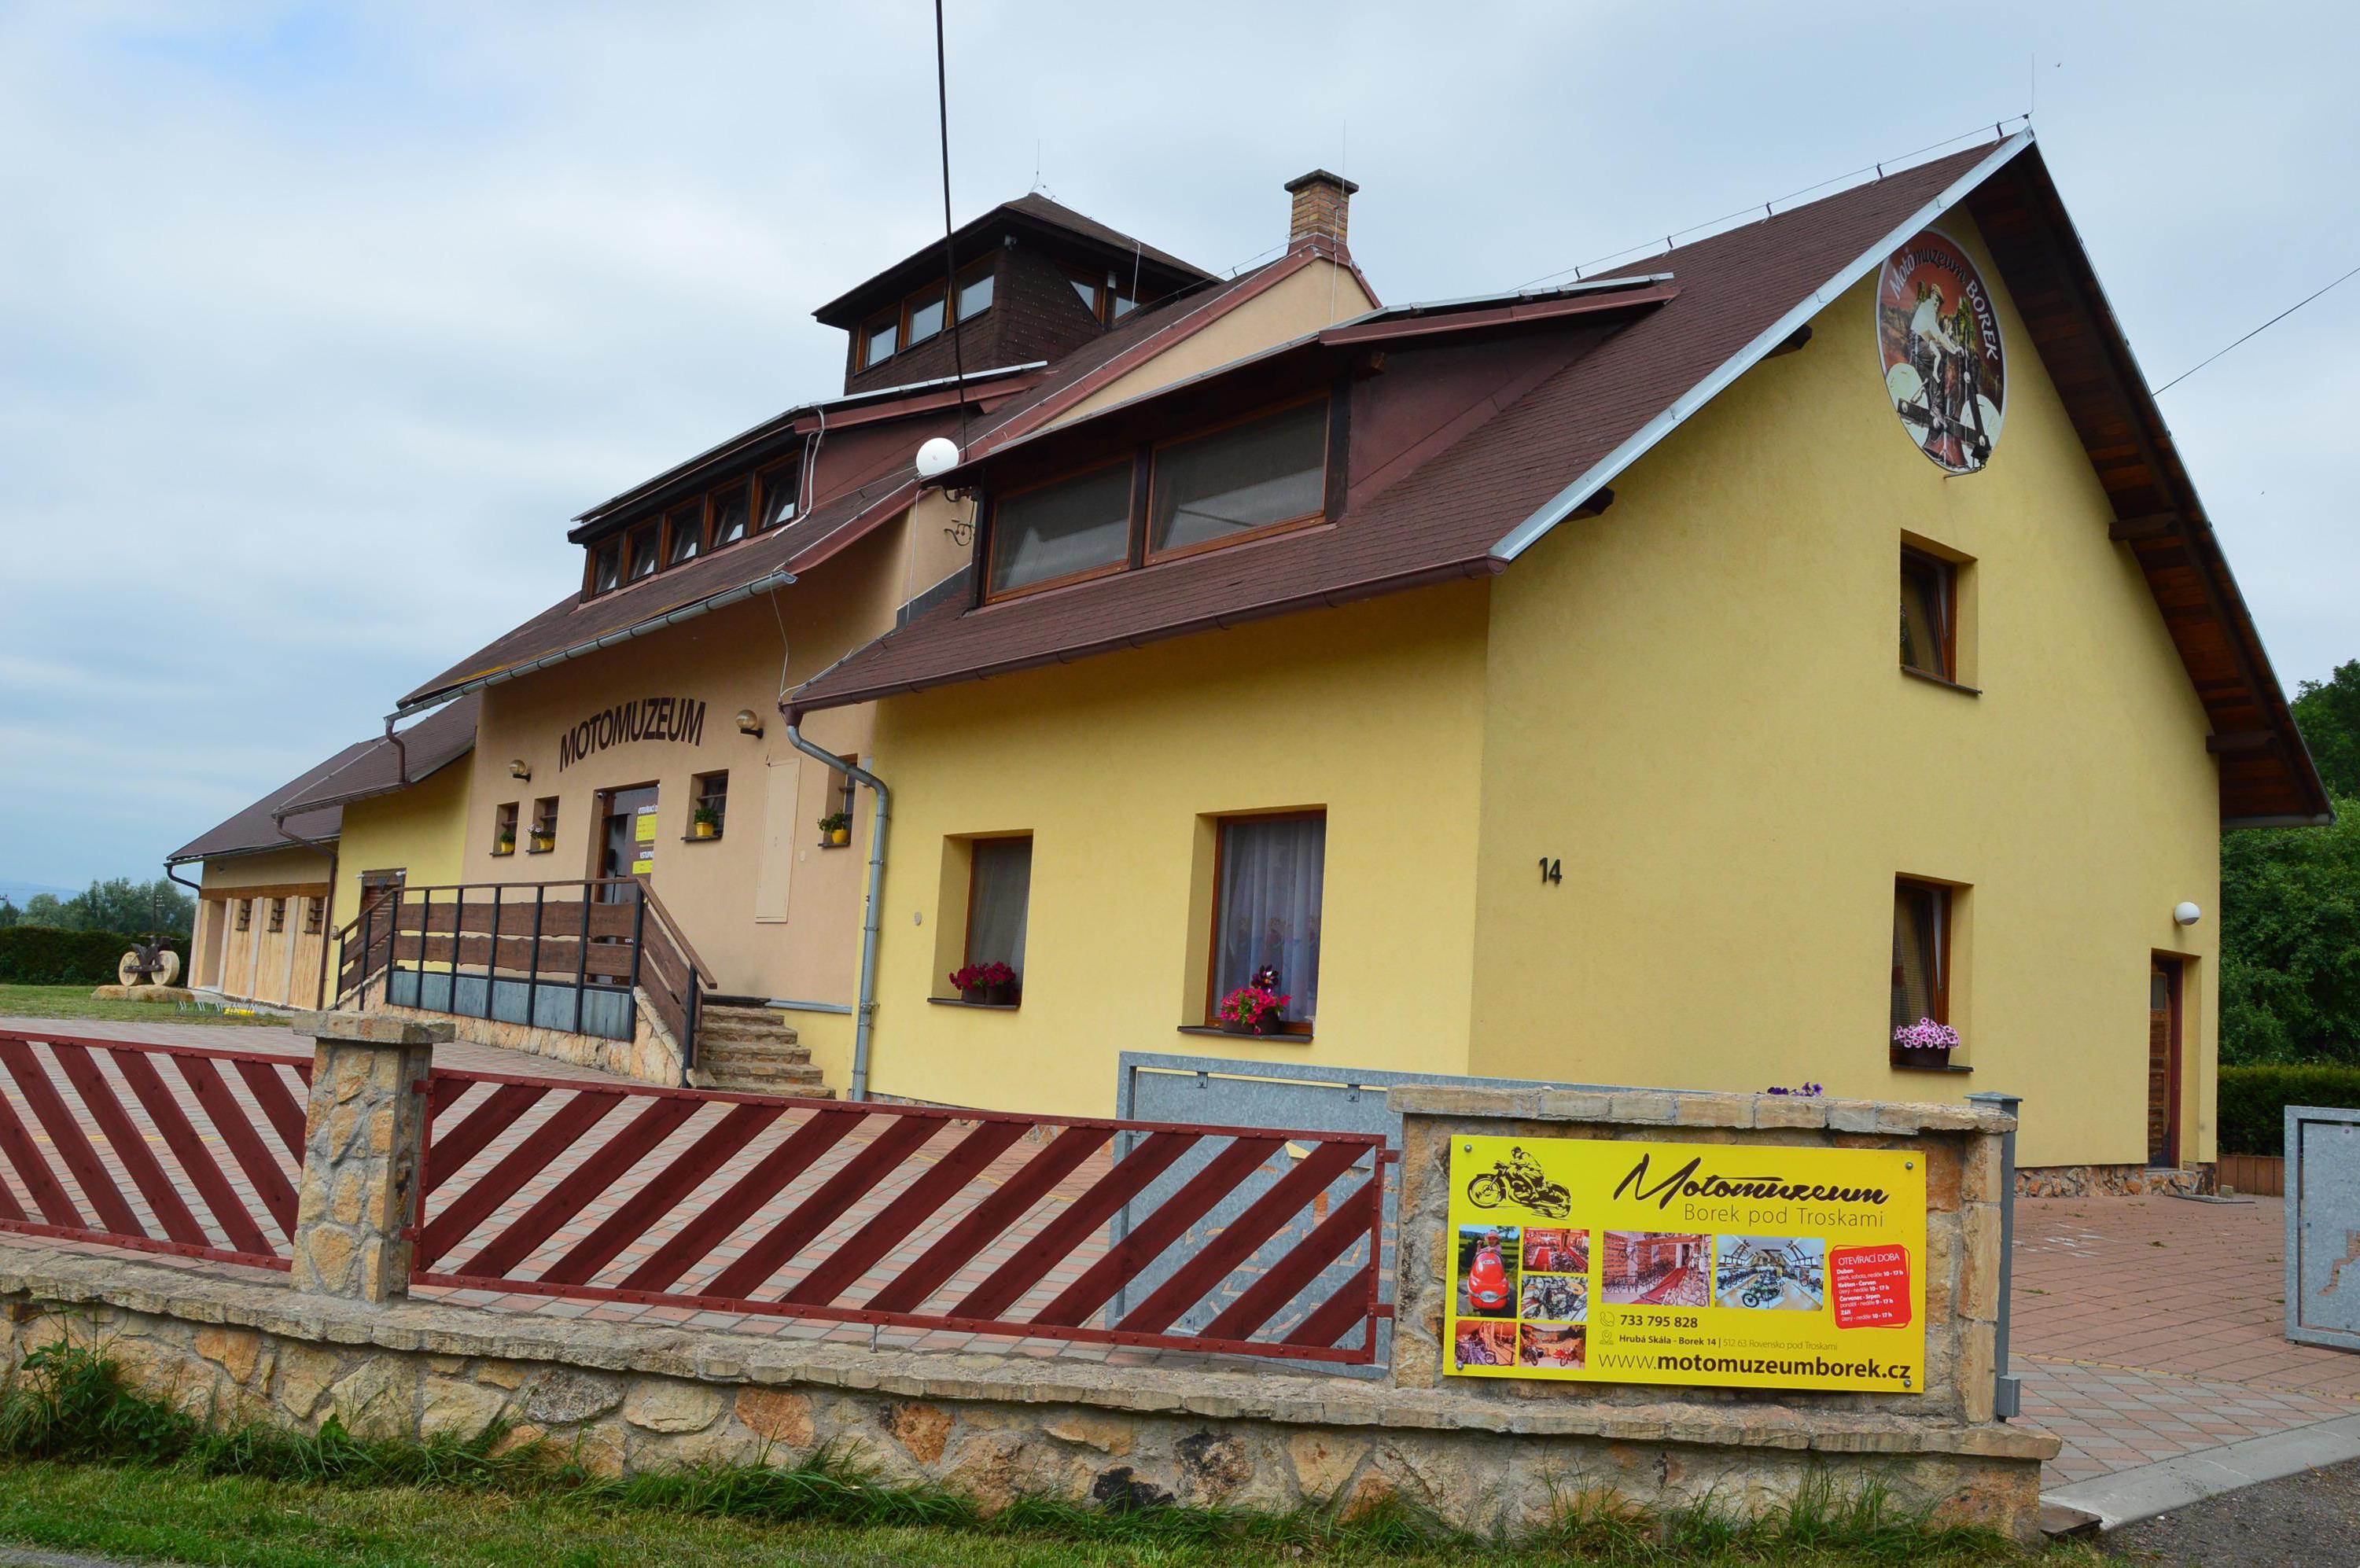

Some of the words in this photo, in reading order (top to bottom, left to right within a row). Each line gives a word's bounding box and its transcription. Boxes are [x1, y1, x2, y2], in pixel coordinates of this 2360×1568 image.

[1889, 247, 1966, 300] Motomuzeum
[1966, 279, 1998, 360] BOREK
[559, 697, 706, 772] MOTOMUZEUM
[1539, 857, 1563, 885] 14
[1614, 1153, 1890, 1209] Motomuzeum
[1684, 1203, 1740, 1222] Borek
[1749, 1206, 1787, 1227] pod
[1796, 1207, 1883, 1228] Troskami
[1838, 1253, 1876, 1266] OTEVÍRACÍ
[1877, 1253, 1900, 1263] DOBA
[1621, 1315, 1643, 1326] 733
[1648, 1316, 1670, 1327] 795
[1673, 1316, 1698, 1328] 828
[1648, 1335, 1671, 1345] Skála
[1723, 1338, 1735, 1347] 512
[1749, 1339, 1785, 1349] Rovensko
[1805, 1342, 1837, 1350] Troskami
[1599, 1354, 1911, 1379] www.motomuzeumborek.cz
